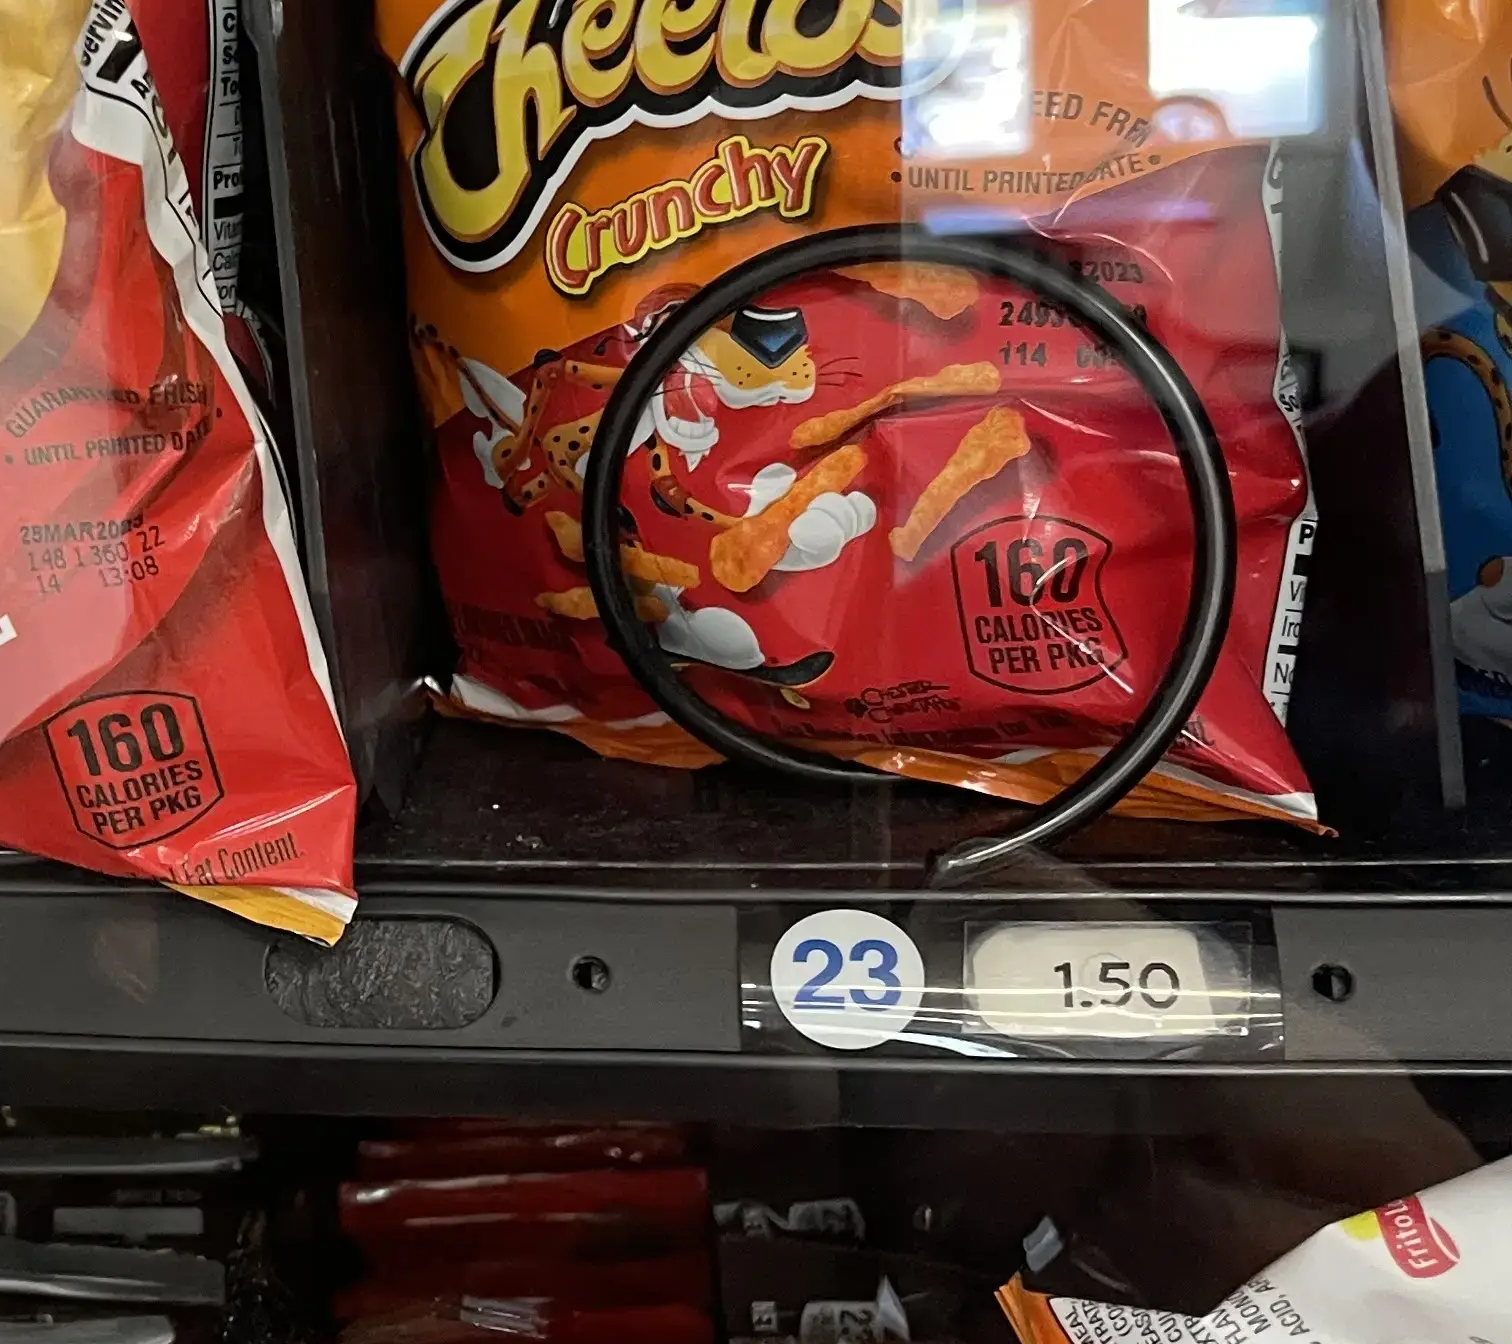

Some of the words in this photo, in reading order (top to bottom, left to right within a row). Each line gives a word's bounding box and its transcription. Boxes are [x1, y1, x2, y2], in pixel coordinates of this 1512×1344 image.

[908, 166, 975, 192] UNTIL
[983, 169, 1084, 195] PRINTED
[546, 134, 831, 296] Crunchy
[999, 340, 1047, 367] 114
[24, 442, 75, 466] UNTIL
[85, 433, 166, 459] PRINTED
[974, 536, 1088, 609] 160
[975, 607, 1104, 645] CALORIES
[989, 644, 1041, 676] PER
[1049, 637, 1105, 671] PKG
[67, 702, 185, 777] 160
[76, 759, 204, 809] CALORIES
[90, 802, 145, 836] PER
[153, 786, 203, 821] PKG
[791, 937, 903, 1014] 23
[1052, 960, 1181, 1010] 1.50
[1266, 1291, 1311, 1341] ACID,
